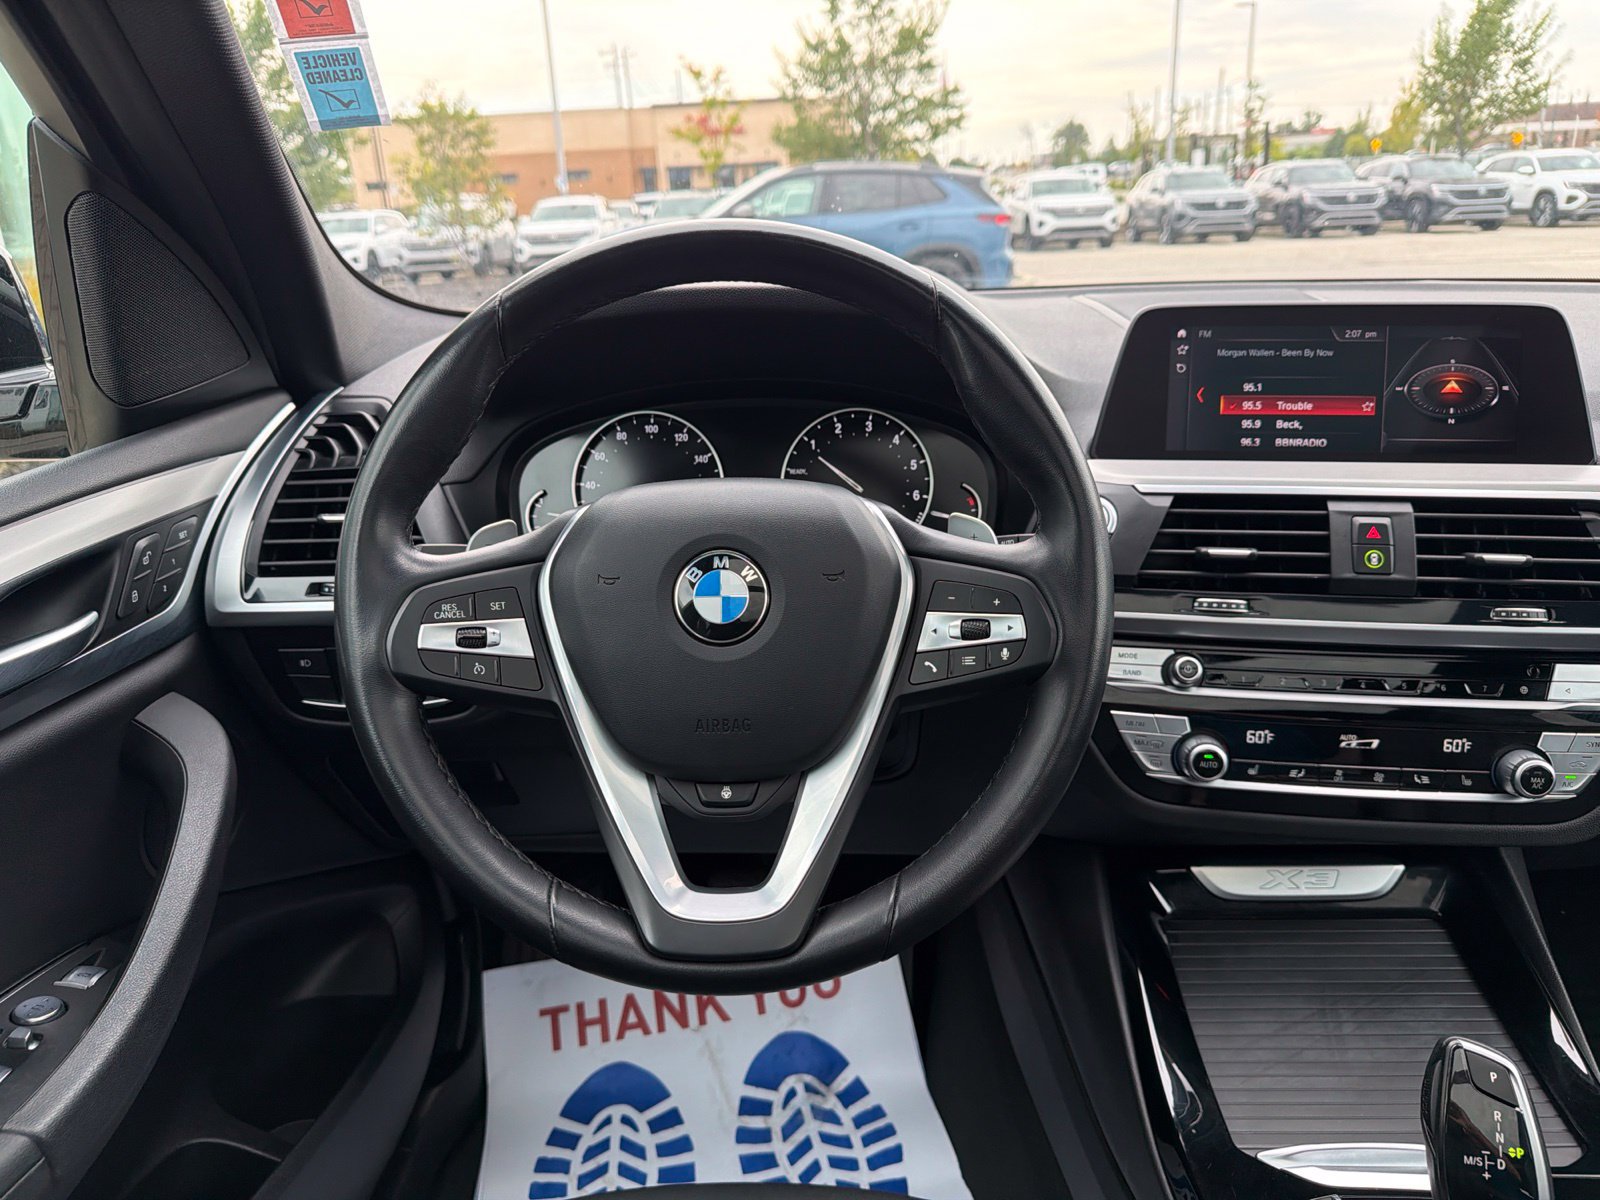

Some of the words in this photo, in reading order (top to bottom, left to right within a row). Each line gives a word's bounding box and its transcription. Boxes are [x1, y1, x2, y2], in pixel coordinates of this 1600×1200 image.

[1198, 330, 1212, 338] FM
[1345, 329, 1362, 338] 2:07
[1365, 331, 1377, 339] pm
[1217, 349, 1247, 359] Morgan
[1248, 349, 1275, 357] Wallen
[1281, 349, 1302, 357] Been
[1304, 349, 1314, 359] By
[1316, 349, 1334, 357] Now
[1243, 383, 1262, 392] 95.1
[1242, 401, 1262, 410] 95.5
[1276, 401, 1313, 410] Trouble
[644, 425, 659, 434] 100
[834, 423, 842, 434] 2
[865, 421, 873, 432] 3
[1241, 420, 1262, 429] 95.9
[1275, 420, 1303, 430] Beck,
[616, 432, 627, 440] 80
[674, 433, 688, 442] 120
[892, 434, 900, 445] 4
[810, 440, 816, 450] 1
[595, 452, 605, 461] 60
[694, 454, 709, 464] 140
[910, 460, 917, 470] 5
[912, 490, 920, 500] 6
[442, 603, 457, 612] RES
[490, 602, 506, 611] SET
[434, 610, 466, 619] CANCEL
[1118, 652, 1139, 660] MODE
[1440, 684, 1447, 692] 6
[694, 718, 752, 733] AIRBAG
[1200, 761, 1218, 769] AUTO
[1259, 869, 1340, 889] X3
[539, 989, 732, 1052] THANK
[1489, 1072, 1498, 1083] P
[1493, 1110, 1502, 1122] R
[1495, 1131, 1504, 1144] N
[1463, 1154, 1483, 1167] M/S
[1497, 1158, 1506, 1170] D
